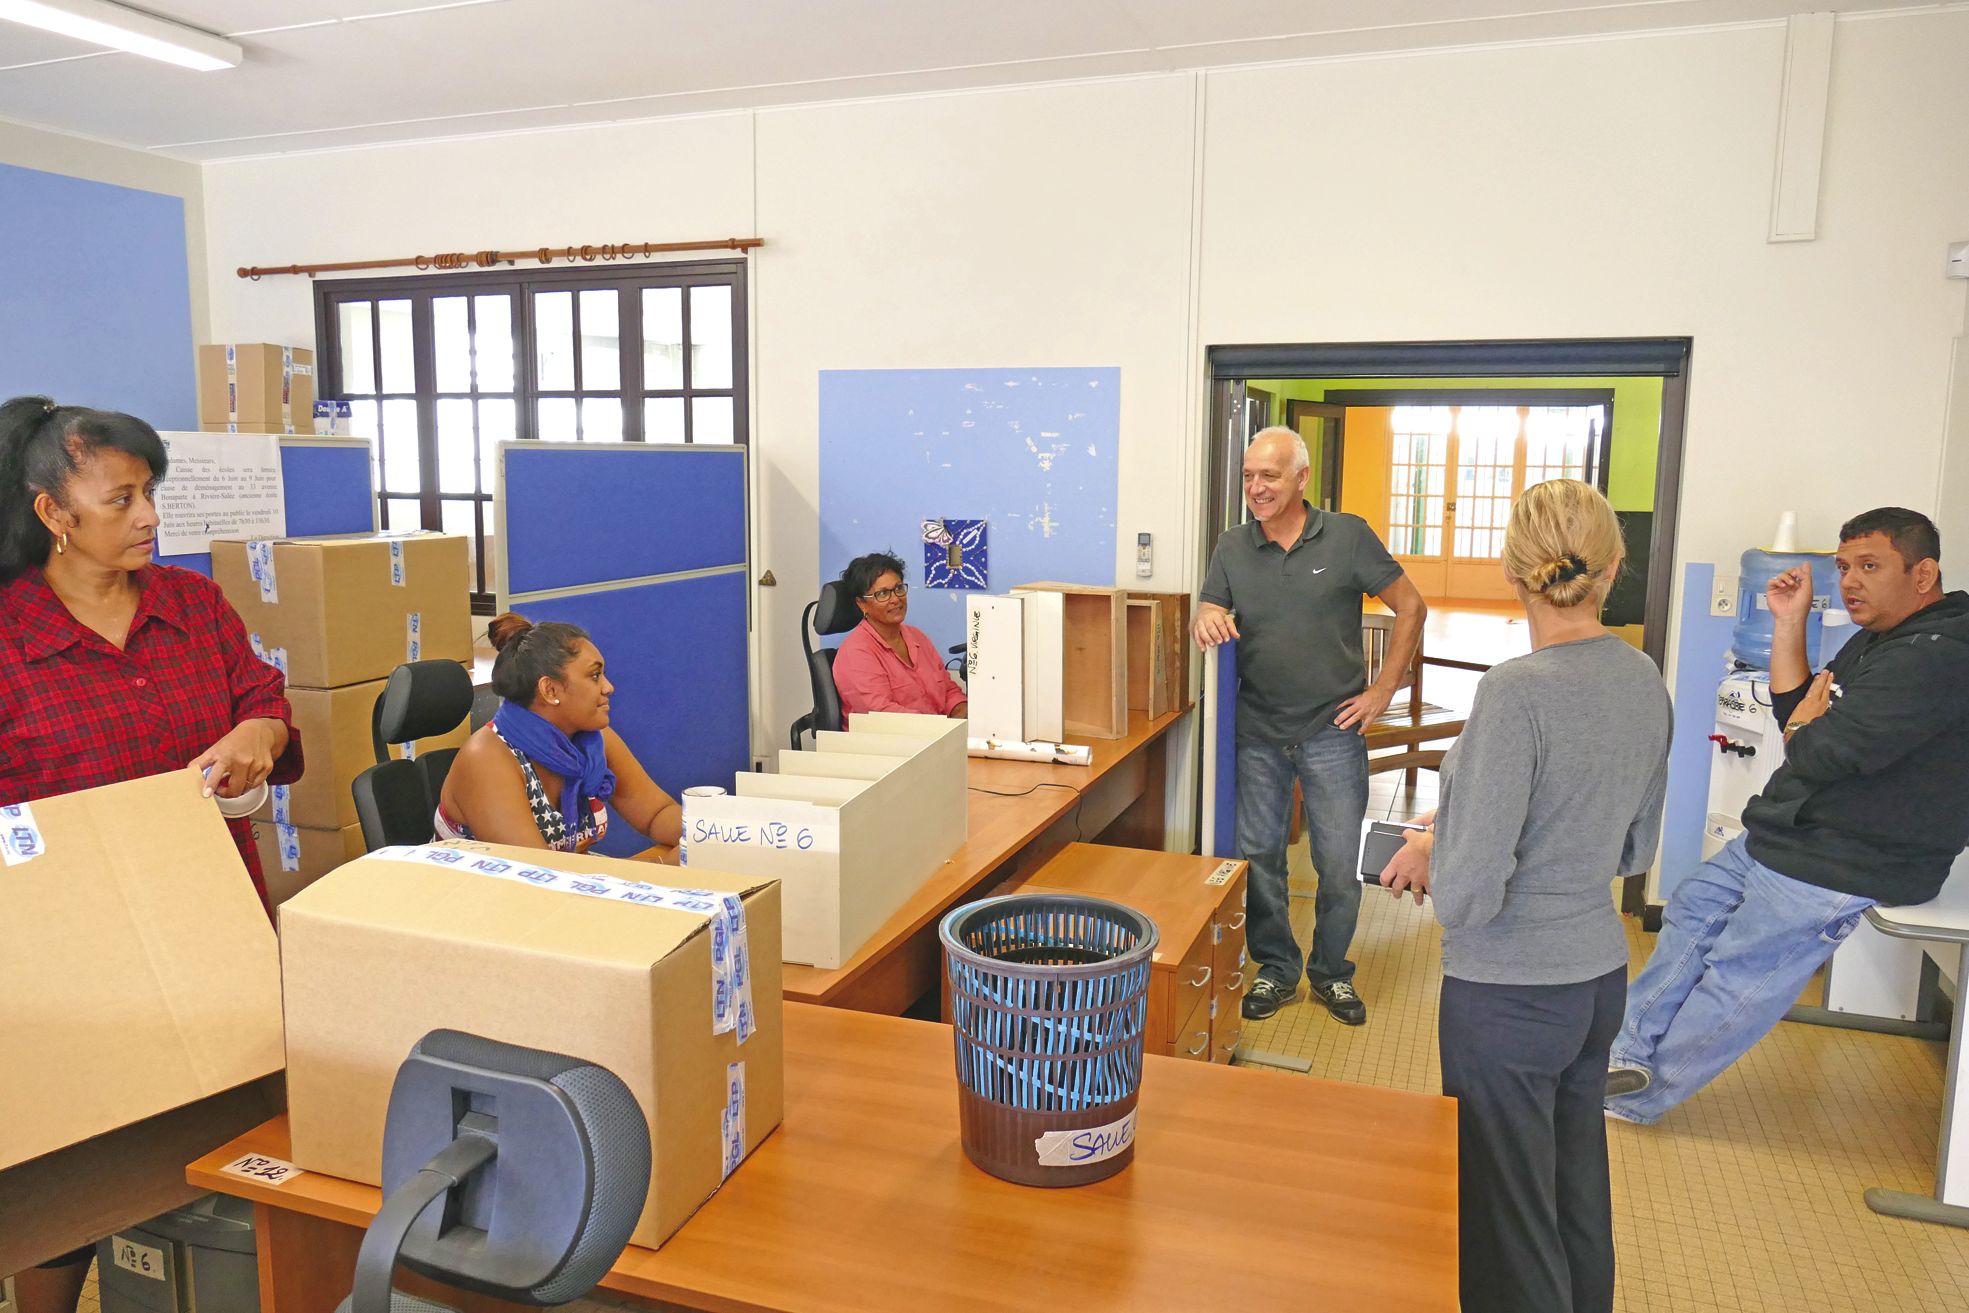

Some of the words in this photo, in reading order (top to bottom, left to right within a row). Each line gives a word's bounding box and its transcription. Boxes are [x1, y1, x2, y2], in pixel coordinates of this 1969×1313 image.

[317, 405, 341, 413] Doue
[1749, 703, 1757, 713] 6
[11, 827, 39, 855] LTN
[796, 828, 814, 850] 6
[425, 850, 465, 864] PGL
[470, 859, 513, 874] LTN
[516, 871, 558, 884] LTP
[568, 880, 612, 896] PGL
[723, 897, 739, 933] LTP
[715, 918, 725, 962] PGL
[716, 979, 726, 1019] LTN
[731, 1081, 739, 1117] LTP
